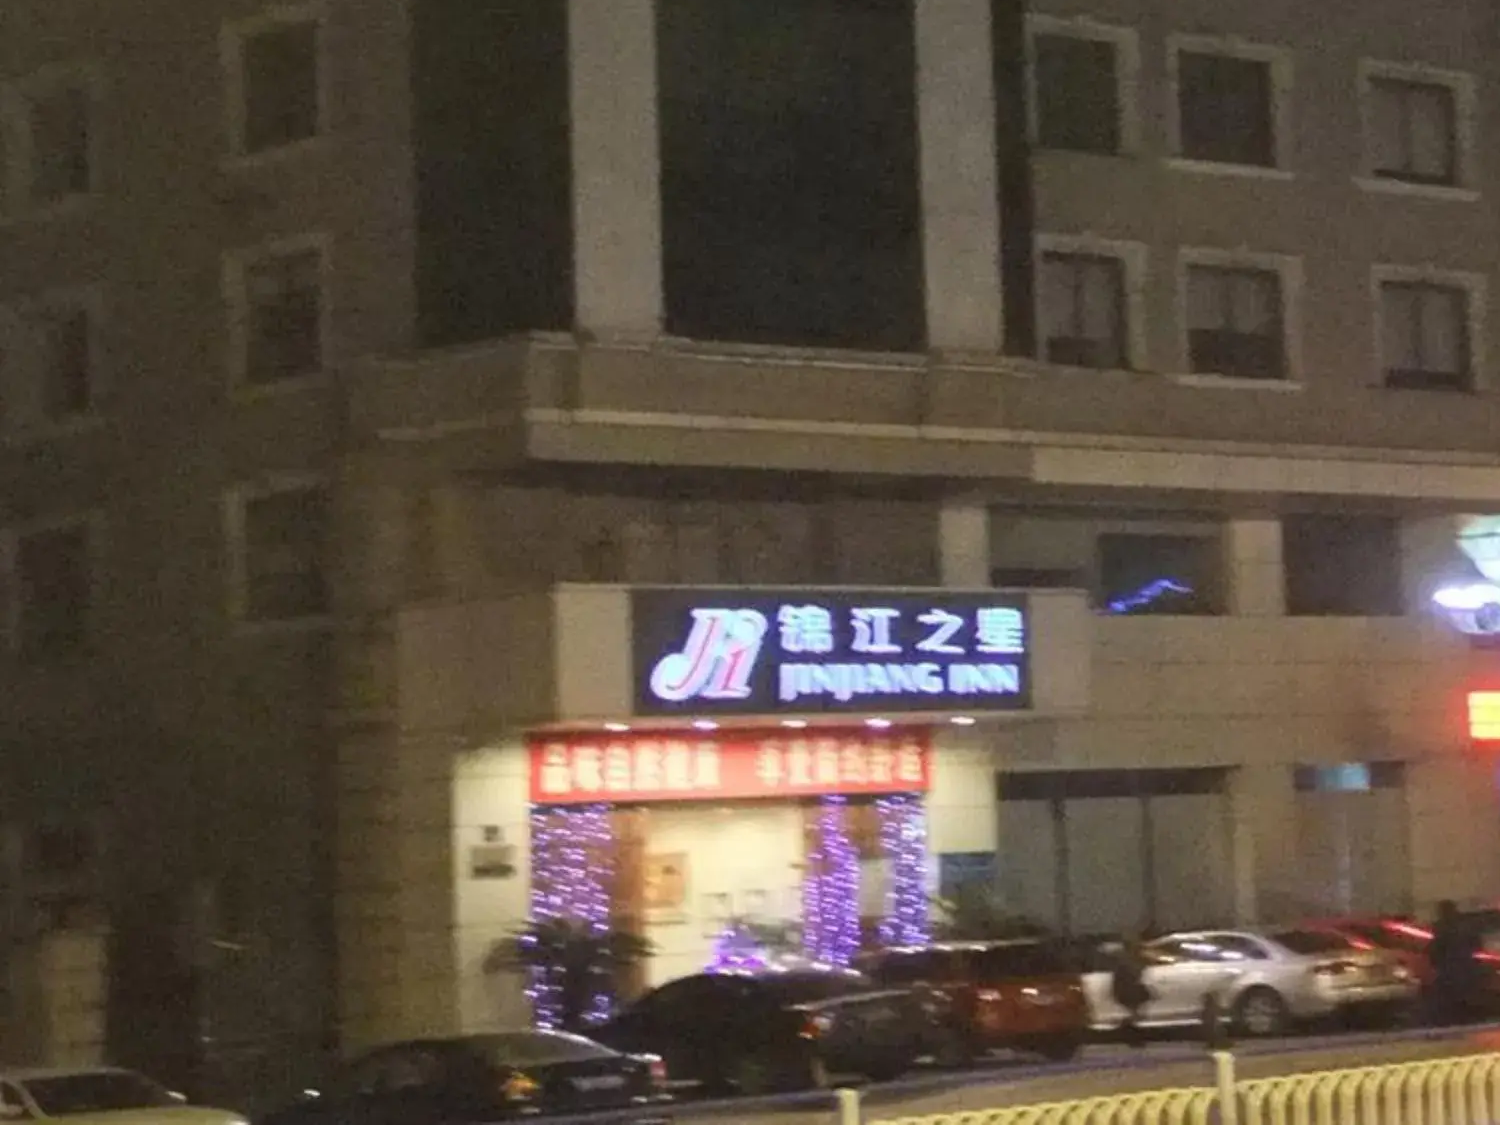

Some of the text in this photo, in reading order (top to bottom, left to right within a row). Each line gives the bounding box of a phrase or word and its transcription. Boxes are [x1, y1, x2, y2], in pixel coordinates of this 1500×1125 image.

[777, 604, 1025, 654] 锦江之星
[779, 662, 1020, 701] JINJIANG INN
